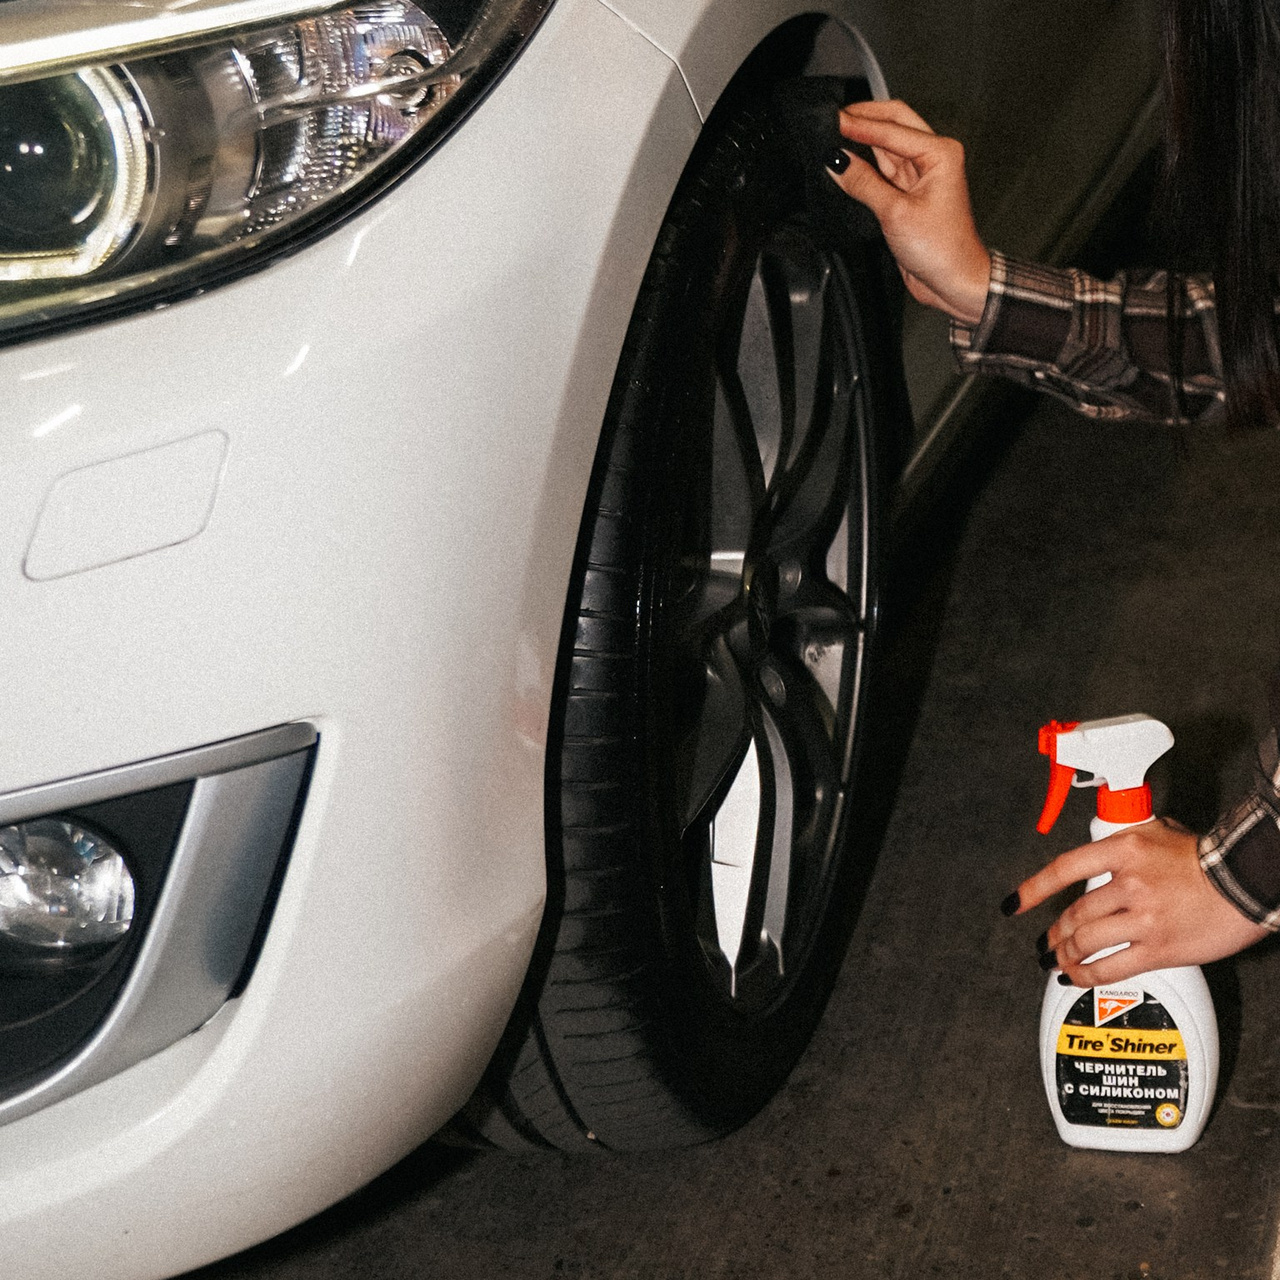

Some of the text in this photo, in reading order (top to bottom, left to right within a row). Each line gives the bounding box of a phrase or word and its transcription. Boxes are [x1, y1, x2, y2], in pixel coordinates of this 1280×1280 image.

[1066, 1034, 1177, 1055] Tire Shiner
[1074, 1061, 1167, 1077] ЧЕРНИТЕЛЬ
[1102, 1075, 1139, 1087] ШИН
[1079, 1085, 1179, 1100] СИЛИКОНОМ
